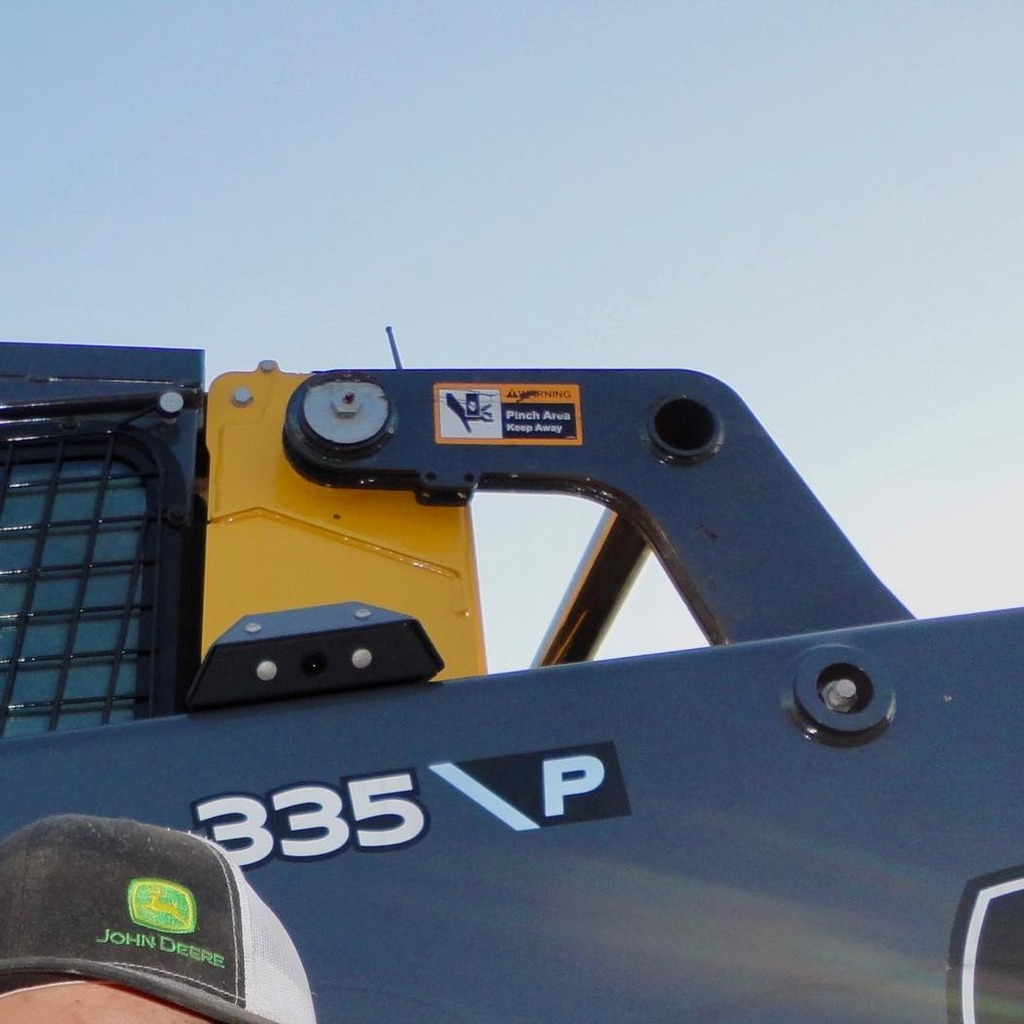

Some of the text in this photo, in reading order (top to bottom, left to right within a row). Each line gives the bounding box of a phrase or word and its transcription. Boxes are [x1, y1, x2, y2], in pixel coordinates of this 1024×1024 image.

[506, 410, 571, 421] Pinch Area
[506, 423, 563, 434] Keep Away
[197, 773, 424, 867] 335
[96, 928, 225, 969] JOHN DEERE
